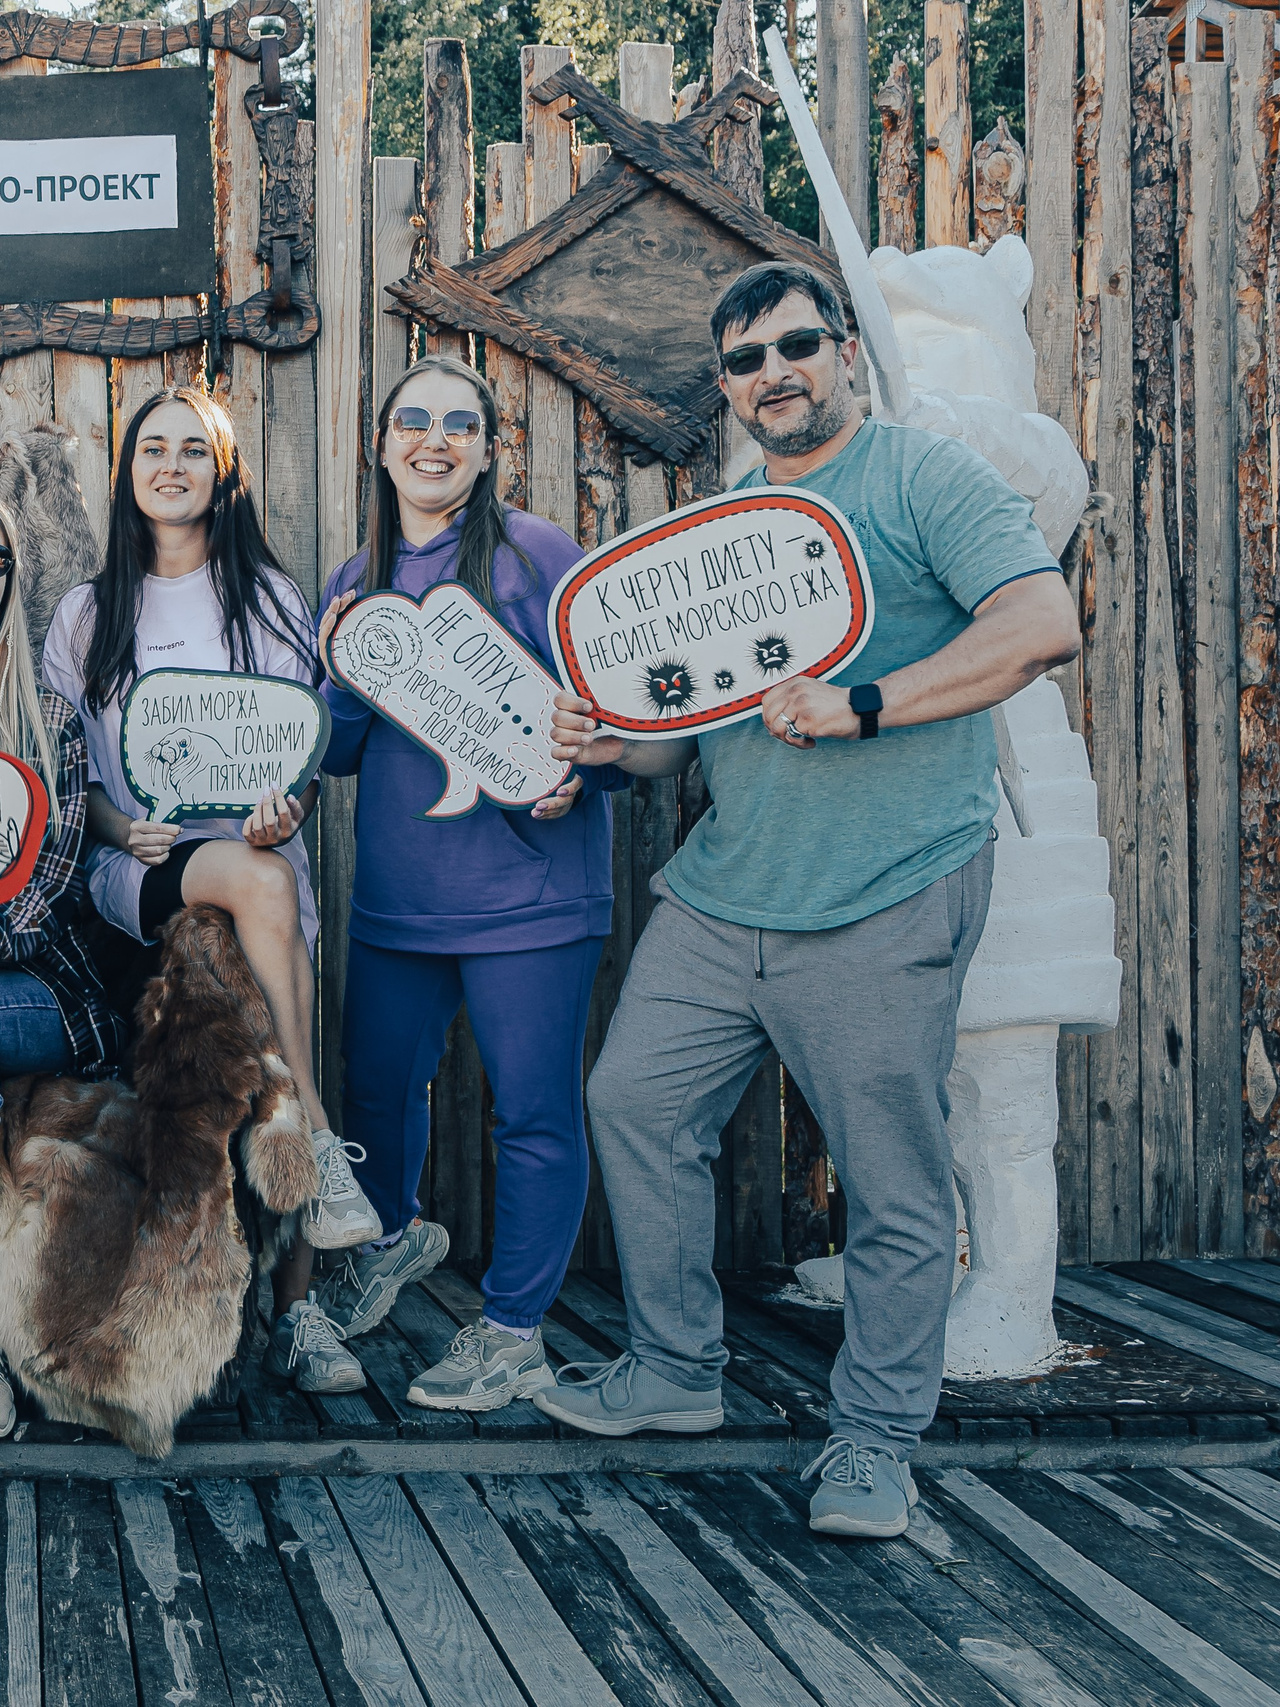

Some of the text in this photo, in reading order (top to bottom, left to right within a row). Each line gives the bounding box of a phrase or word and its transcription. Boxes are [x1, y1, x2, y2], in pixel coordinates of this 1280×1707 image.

[595, 582, 622, 623] К
[619, 557, 693, 613] ЧЕРТУ
[700, 529, 776, 591] ДИЕТУ
[423, 601, 473, 646] НЕ
[583, 566, 840, 673] НЕСИТЕ МОРСКОГО ЕЖА
[147, 640, 185, 652] interesno
[141, 689, 260, 726] ЗАБИЛ МОРЖА
[403, 669, 504, 739] ПРОСТО КОШУ
[234, 721, 305, 756] ГОЛЫМИ
[420, 711, 528, 797] ПОД ЭСКИМОСА
[209, 761, 283, 792] ПЯТКАМИ
